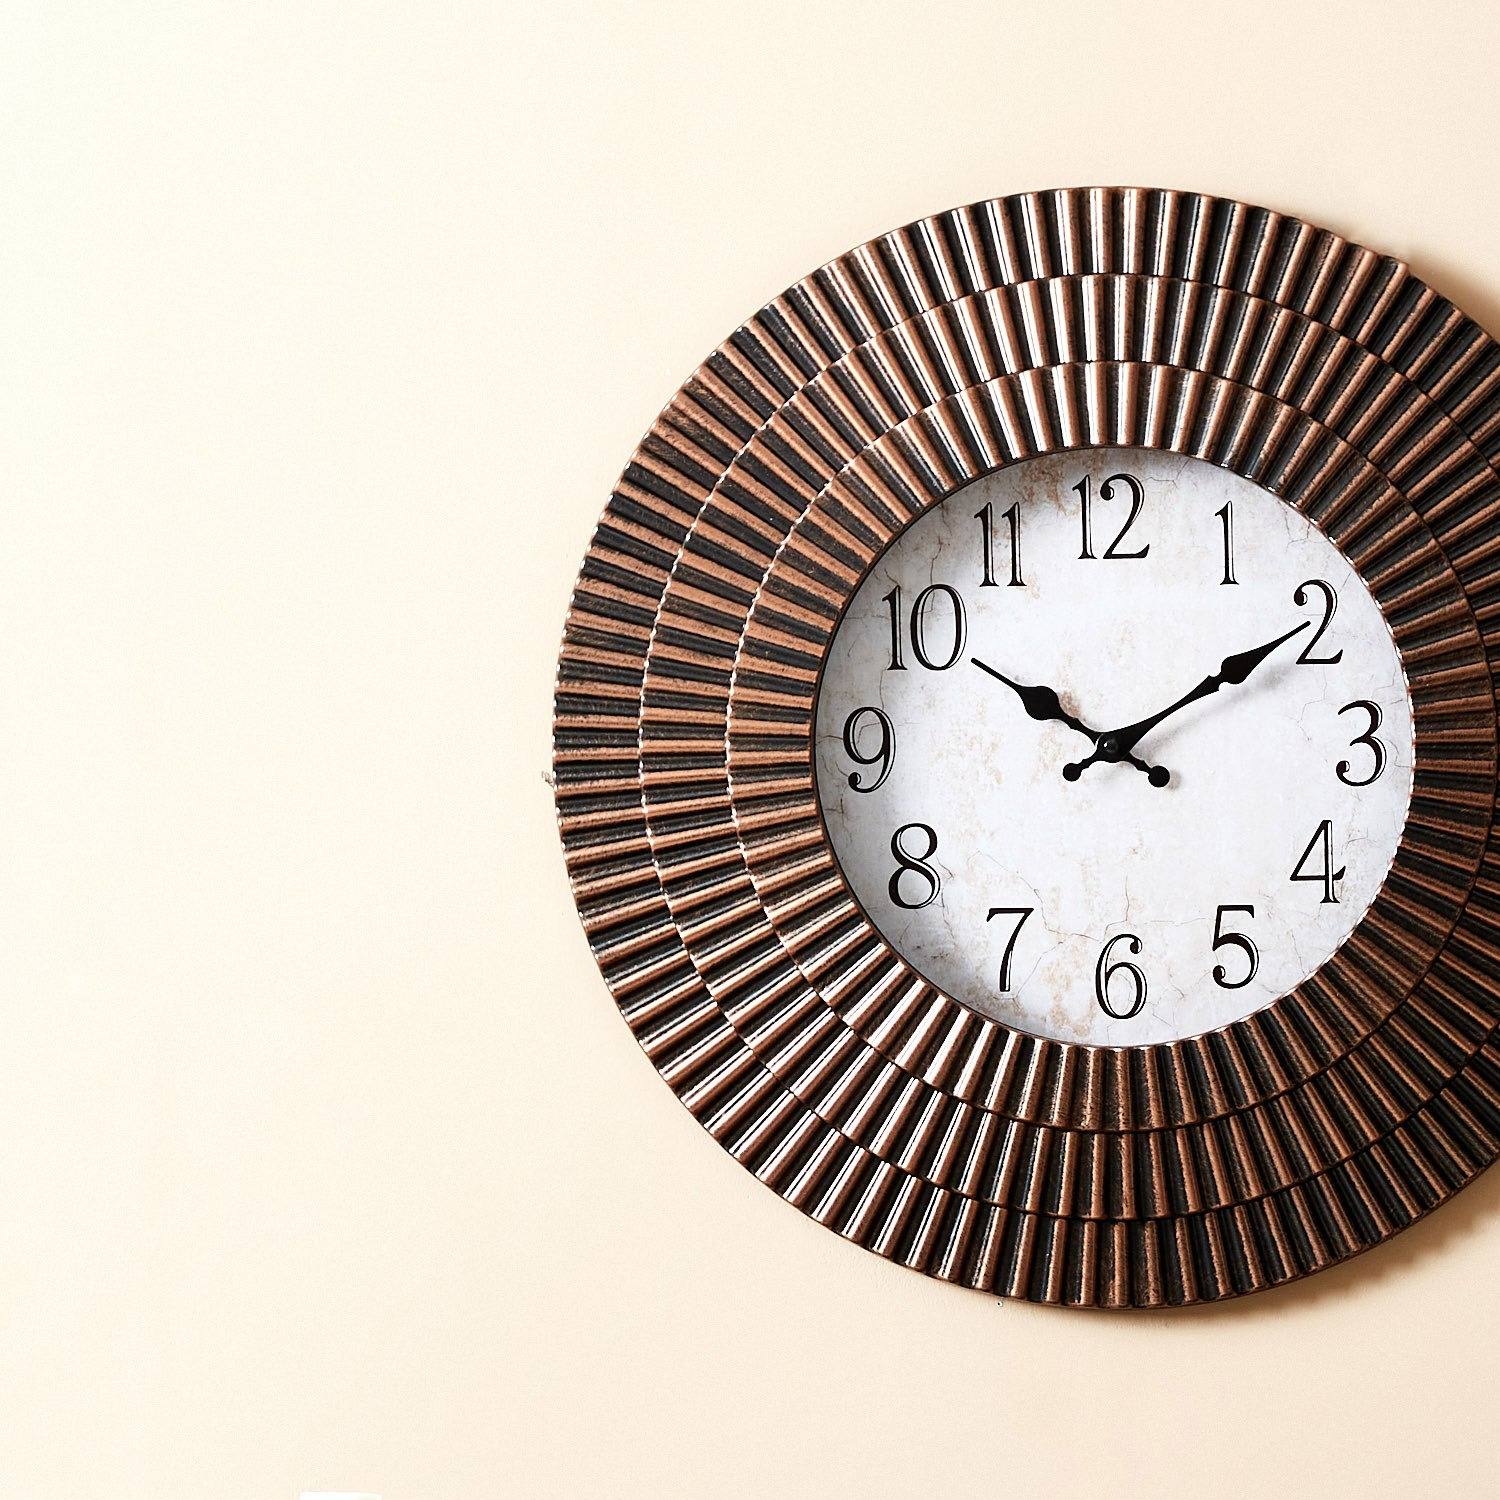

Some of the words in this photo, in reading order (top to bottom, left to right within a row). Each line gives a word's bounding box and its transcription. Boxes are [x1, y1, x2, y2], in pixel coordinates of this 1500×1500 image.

[973, 501, 1028, 588] 11
[1071, 472, 1150, 560] 12
[1214, 500, 1240, 585] 1
[881, 583, 968, 671] 10
[1293, 578, 1343, 665] 2
[842, 706, 896, 793] 9
[1336, 700, 1387, 787] 3
[888, 822, 941, 909] 8
[1289, 819, 1346, 904] 4
[986, 907, 1035, 993] 7
[1095, 933, 1148, 1019] 6
[1212, 904, 1260, 989] 5
